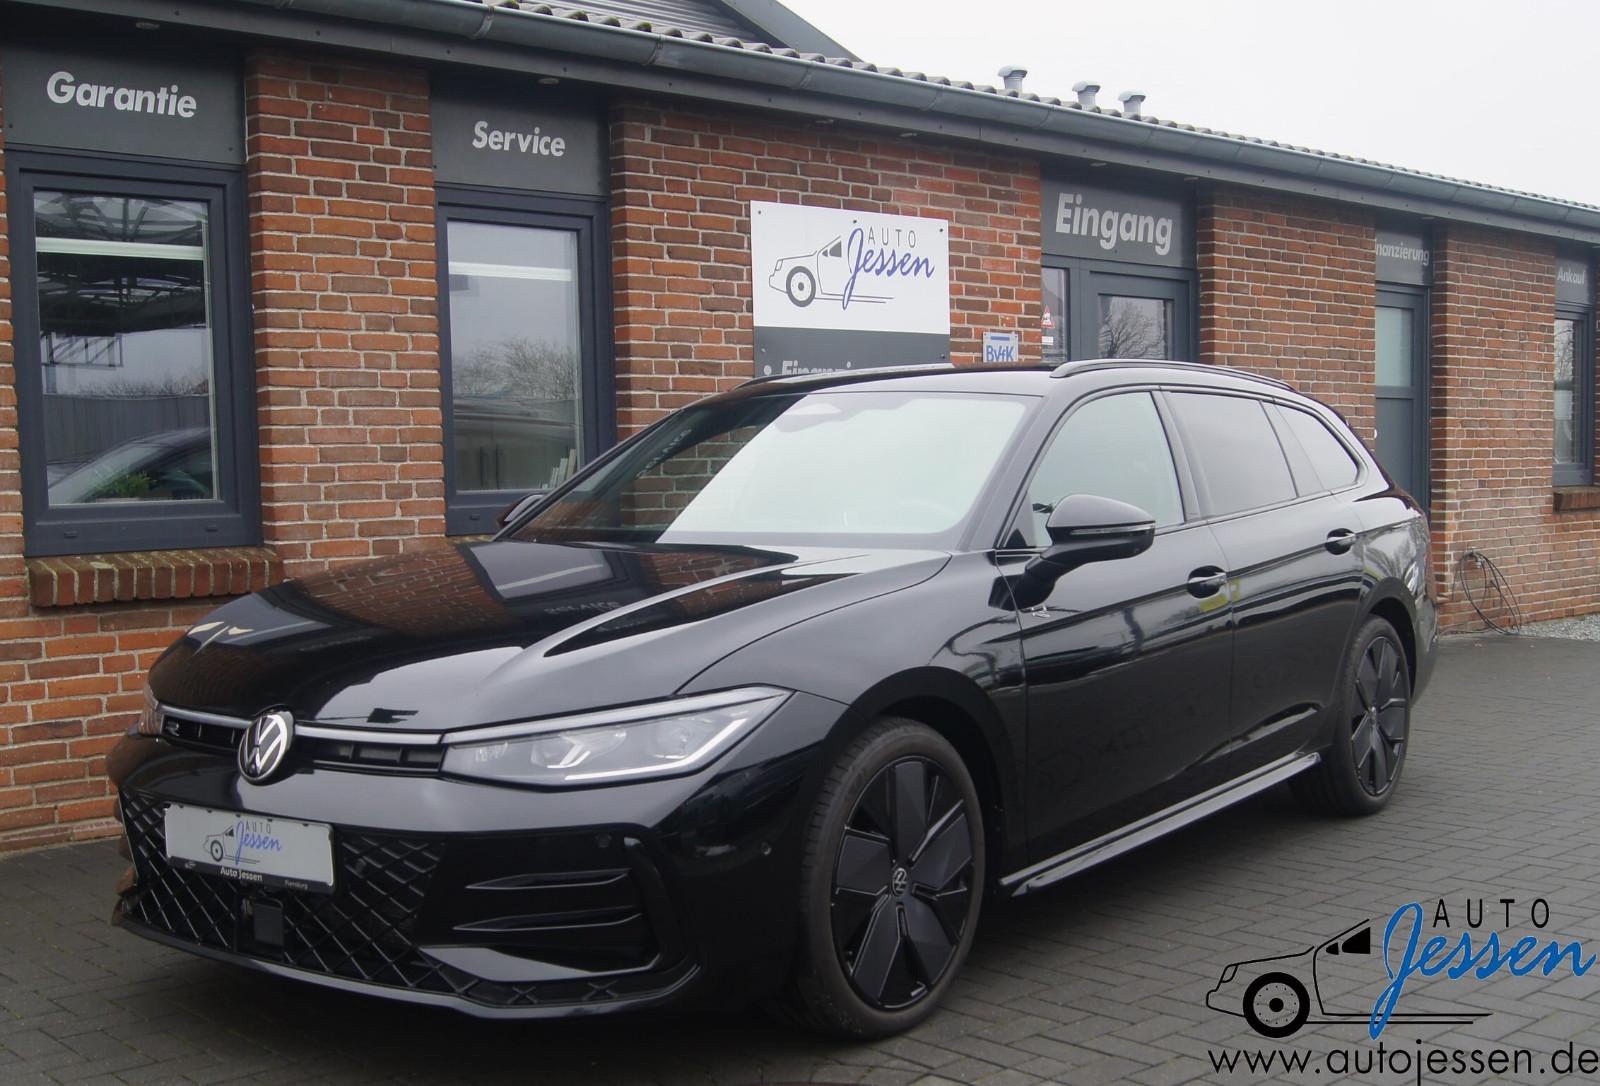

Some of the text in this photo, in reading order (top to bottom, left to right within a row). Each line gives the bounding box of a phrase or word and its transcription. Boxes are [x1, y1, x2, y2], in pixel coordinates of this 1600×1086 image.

[46, 71, 197, 118] Garantie
[472, 120, 566, 157] Service
[868, 226, 916, 248] AUTO
[1055, 192, 1173, 256] Eingang
[842, 227, 935, 310] Jessen
[1375, 241, 1430, 266] nanzierung
[235, 820, 282, 865] Jessen
[245, 820, 272, 834] AUTO
[220, 866, 238, 877] Auto
